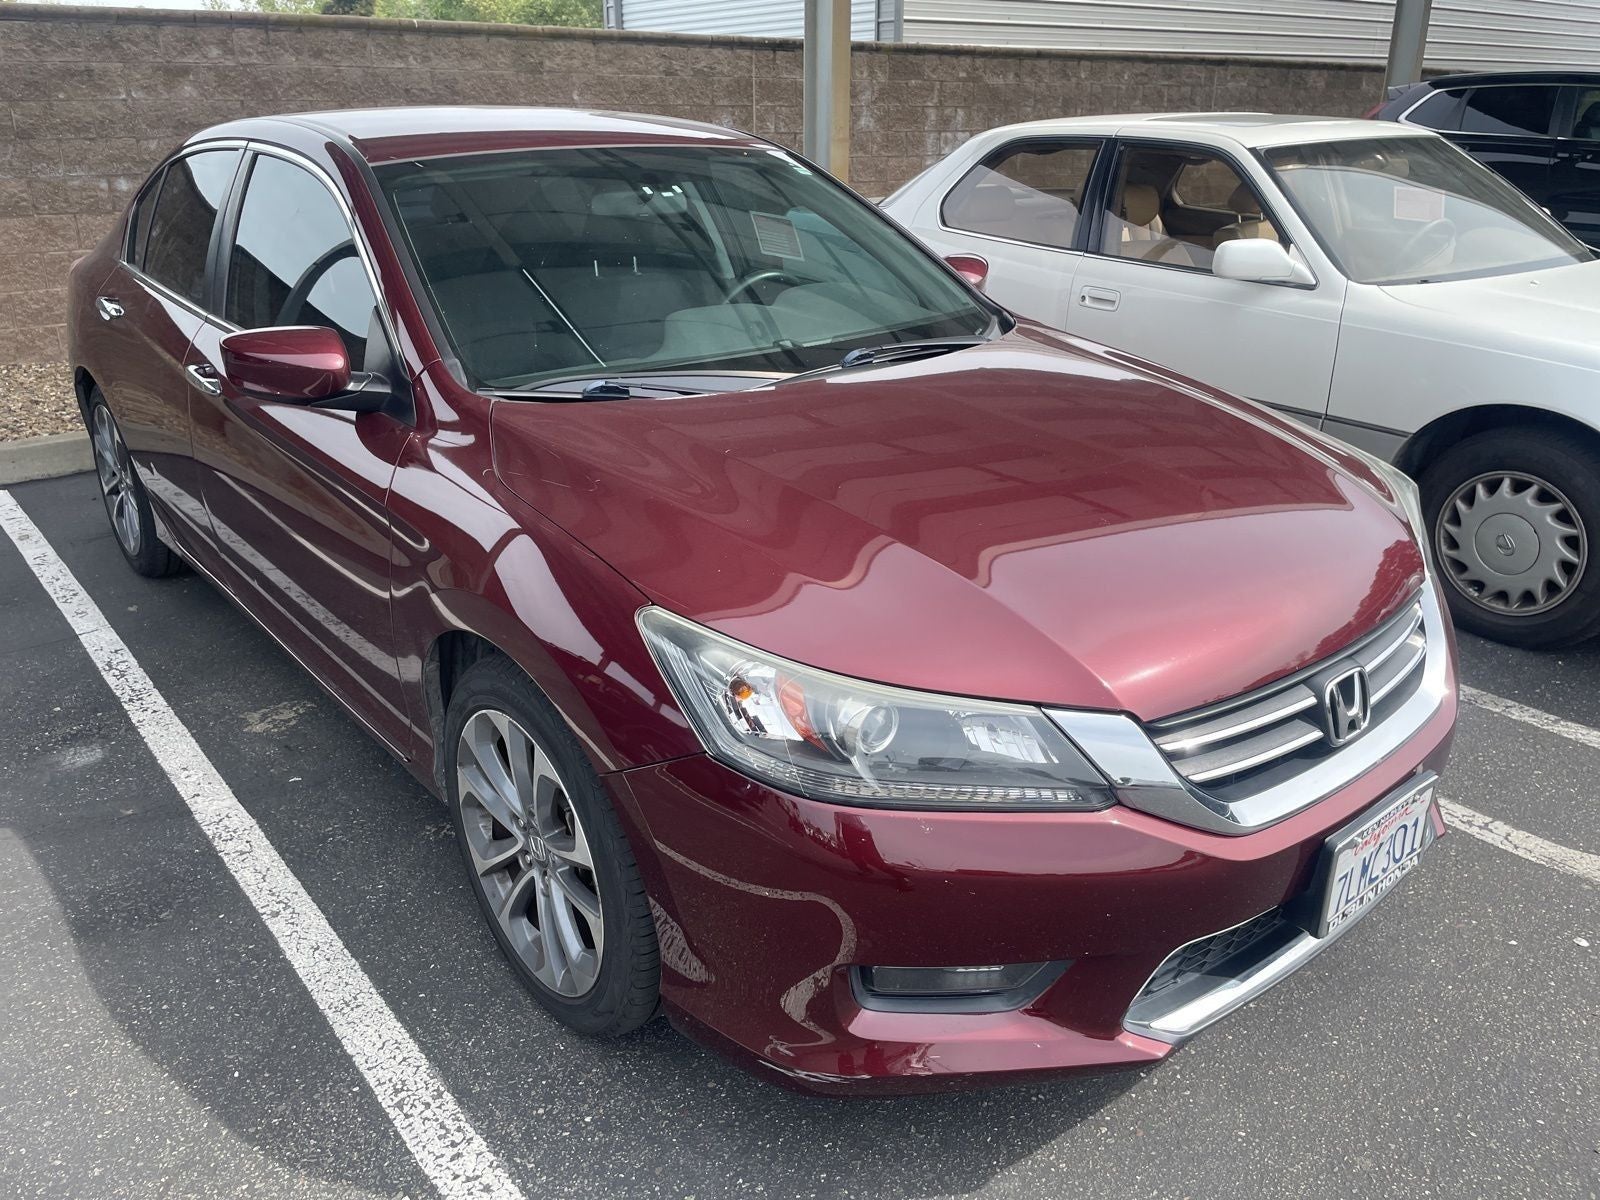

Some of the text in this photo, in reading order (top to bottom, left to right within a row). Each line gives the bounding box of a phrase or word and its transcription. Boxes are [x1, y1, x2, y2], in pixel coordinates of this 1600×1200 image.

[1328, 855, 1419, 934] DUBLIN HONDA
[1338, 816, 1419, 916] 7LMC301
